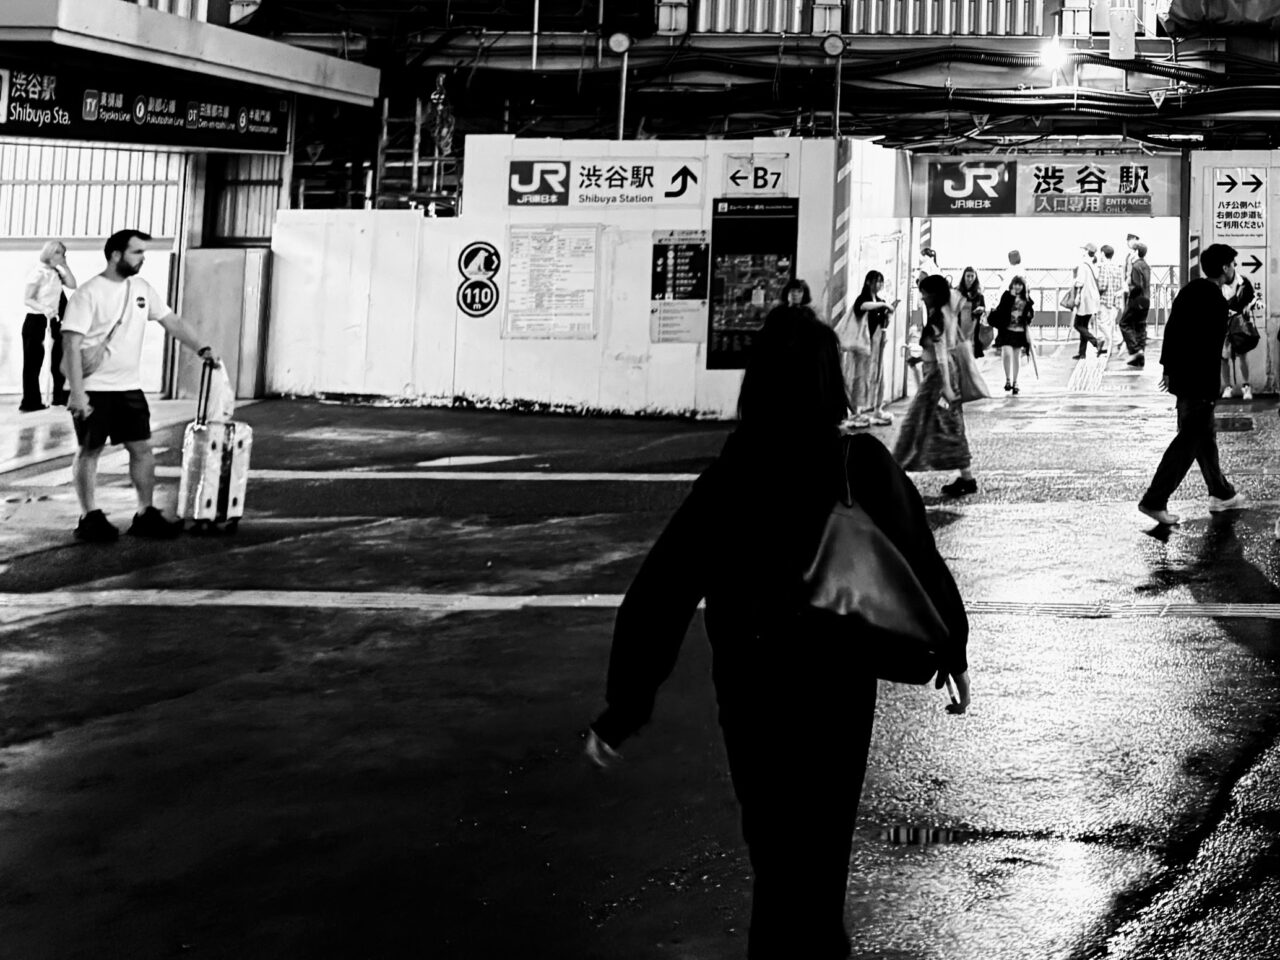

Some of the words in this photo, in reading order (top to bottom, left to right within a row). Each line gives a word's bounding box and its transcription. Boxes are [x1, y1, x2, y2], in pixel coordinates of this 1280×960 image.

[11, 70, 57, 101] 渋谷駅
[86, 97, 98, 112] TY
[9, 101, 52, 128] Shibuya
[53, 106, 72, 126] Sta.
[510, 162, 567, 193] JR
[579, 164, 655, 189] 渋谷駅
[753, 166, 782, 189] B7
[943, 167, 999, 198] JR
[1033, 164, 1151, 194] 渋谷駅
[578, 193, 617, 205] Shibuya
[619, 193, 654, 204] Station
[950, 199, 993, 209] JR東日本
[1036, 196, 1101, 213] 入口専用
[1105, 197, 1149, 207] ENTRANCE
[1217, 200, 1263, 210] ハチ公側へは
[1216, 210, 1263, 220] 右側の歩道を
[1215, 220, 1265, 230] ご利用ください
[464, 287, 492, 304] 110
